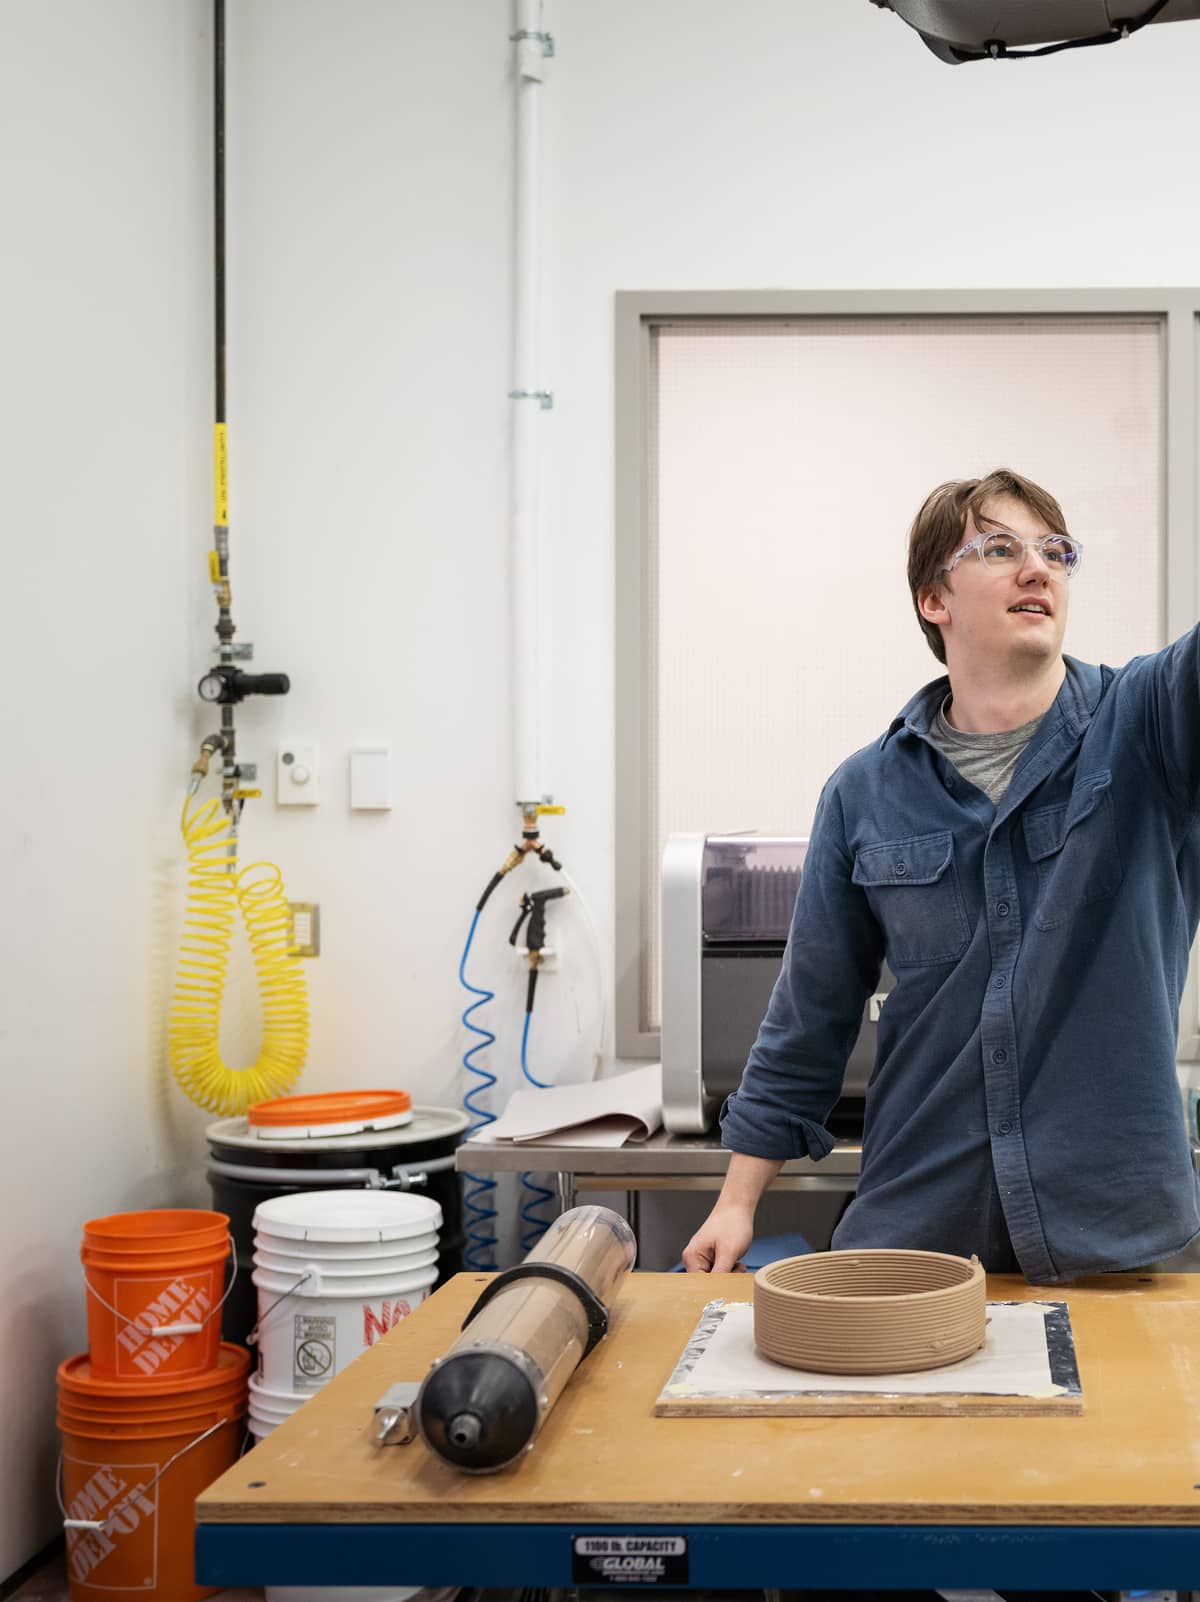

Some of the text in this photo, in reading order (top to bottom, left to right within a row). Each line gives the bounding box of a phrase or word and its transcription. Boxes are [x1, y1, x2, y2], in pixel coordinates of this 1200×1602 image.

[117, 1276, 195, 1355] HOME
[72, 1484, 156, 1583] DEPOT
[626, 1541, 676, 1551] CAPACITY
[603, 1557, 664, 1570] GLOBAL
